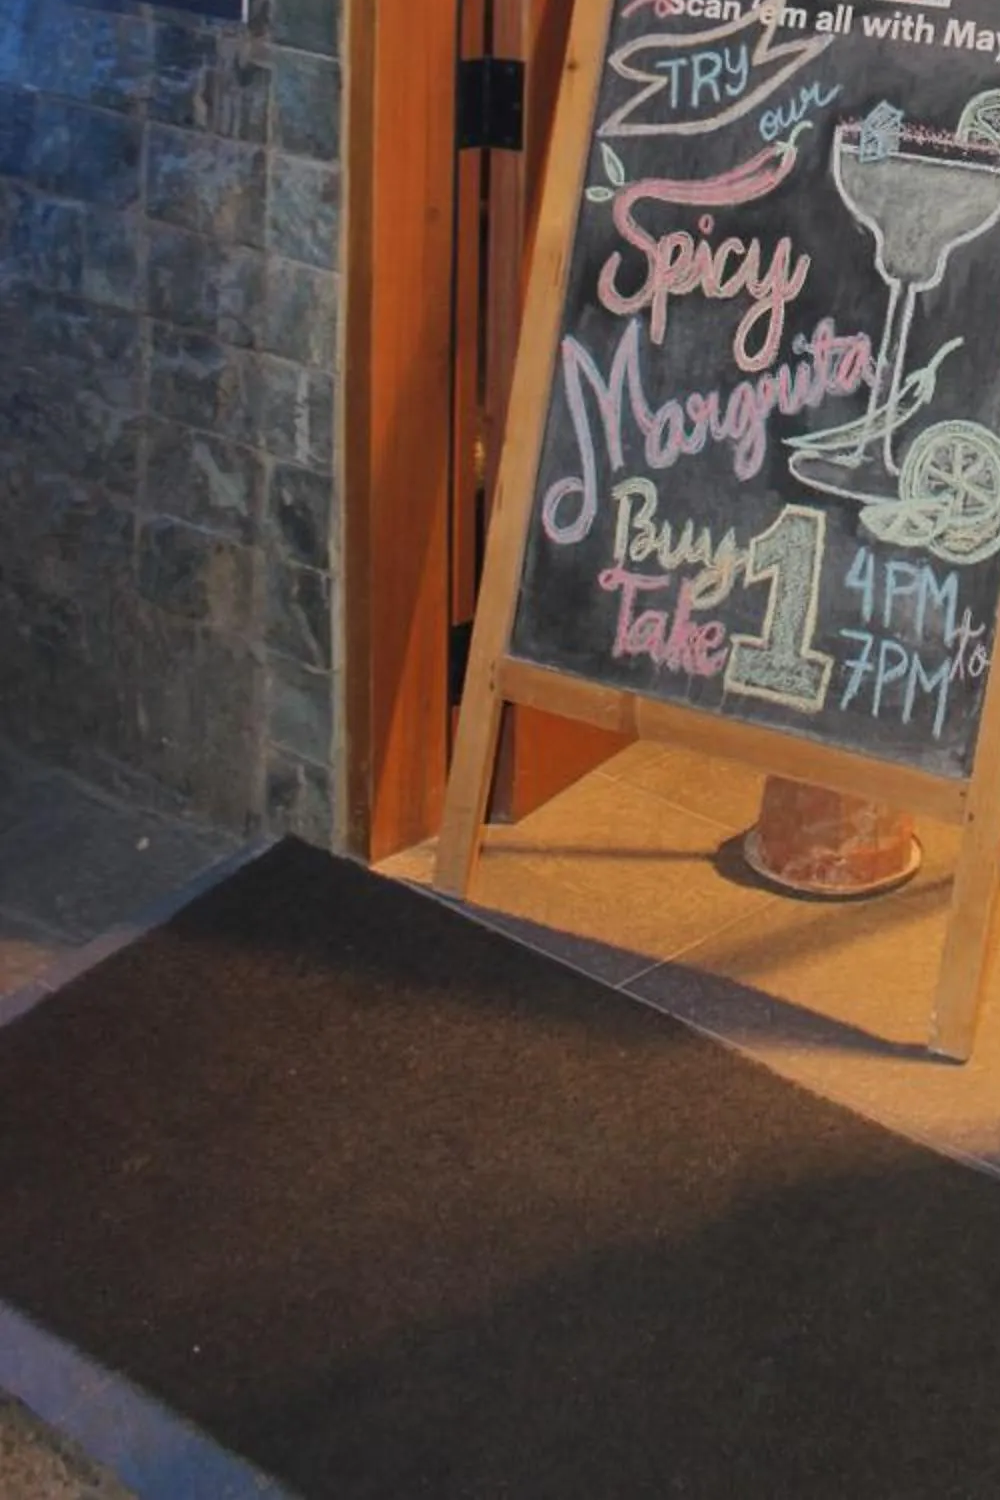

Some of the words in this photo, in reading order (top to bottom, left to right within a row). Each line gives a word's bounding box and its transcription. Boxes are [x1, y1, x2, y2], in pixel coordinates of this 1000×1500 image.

[656, 44, 750, 109] TRY
[815, 4, 854, 35] all
[862, 12, 936, 45] with
[759, 83, 844, 142] our
[597, 176, 812, 373] Spicy
[597, 567, 729, 677] Take
[611, 477, 748, 610] Buy
[723, 502, 835, 713] 1
[844, 545, 959, 648] 4PM
[838, 627, 952, 740] 7PM
